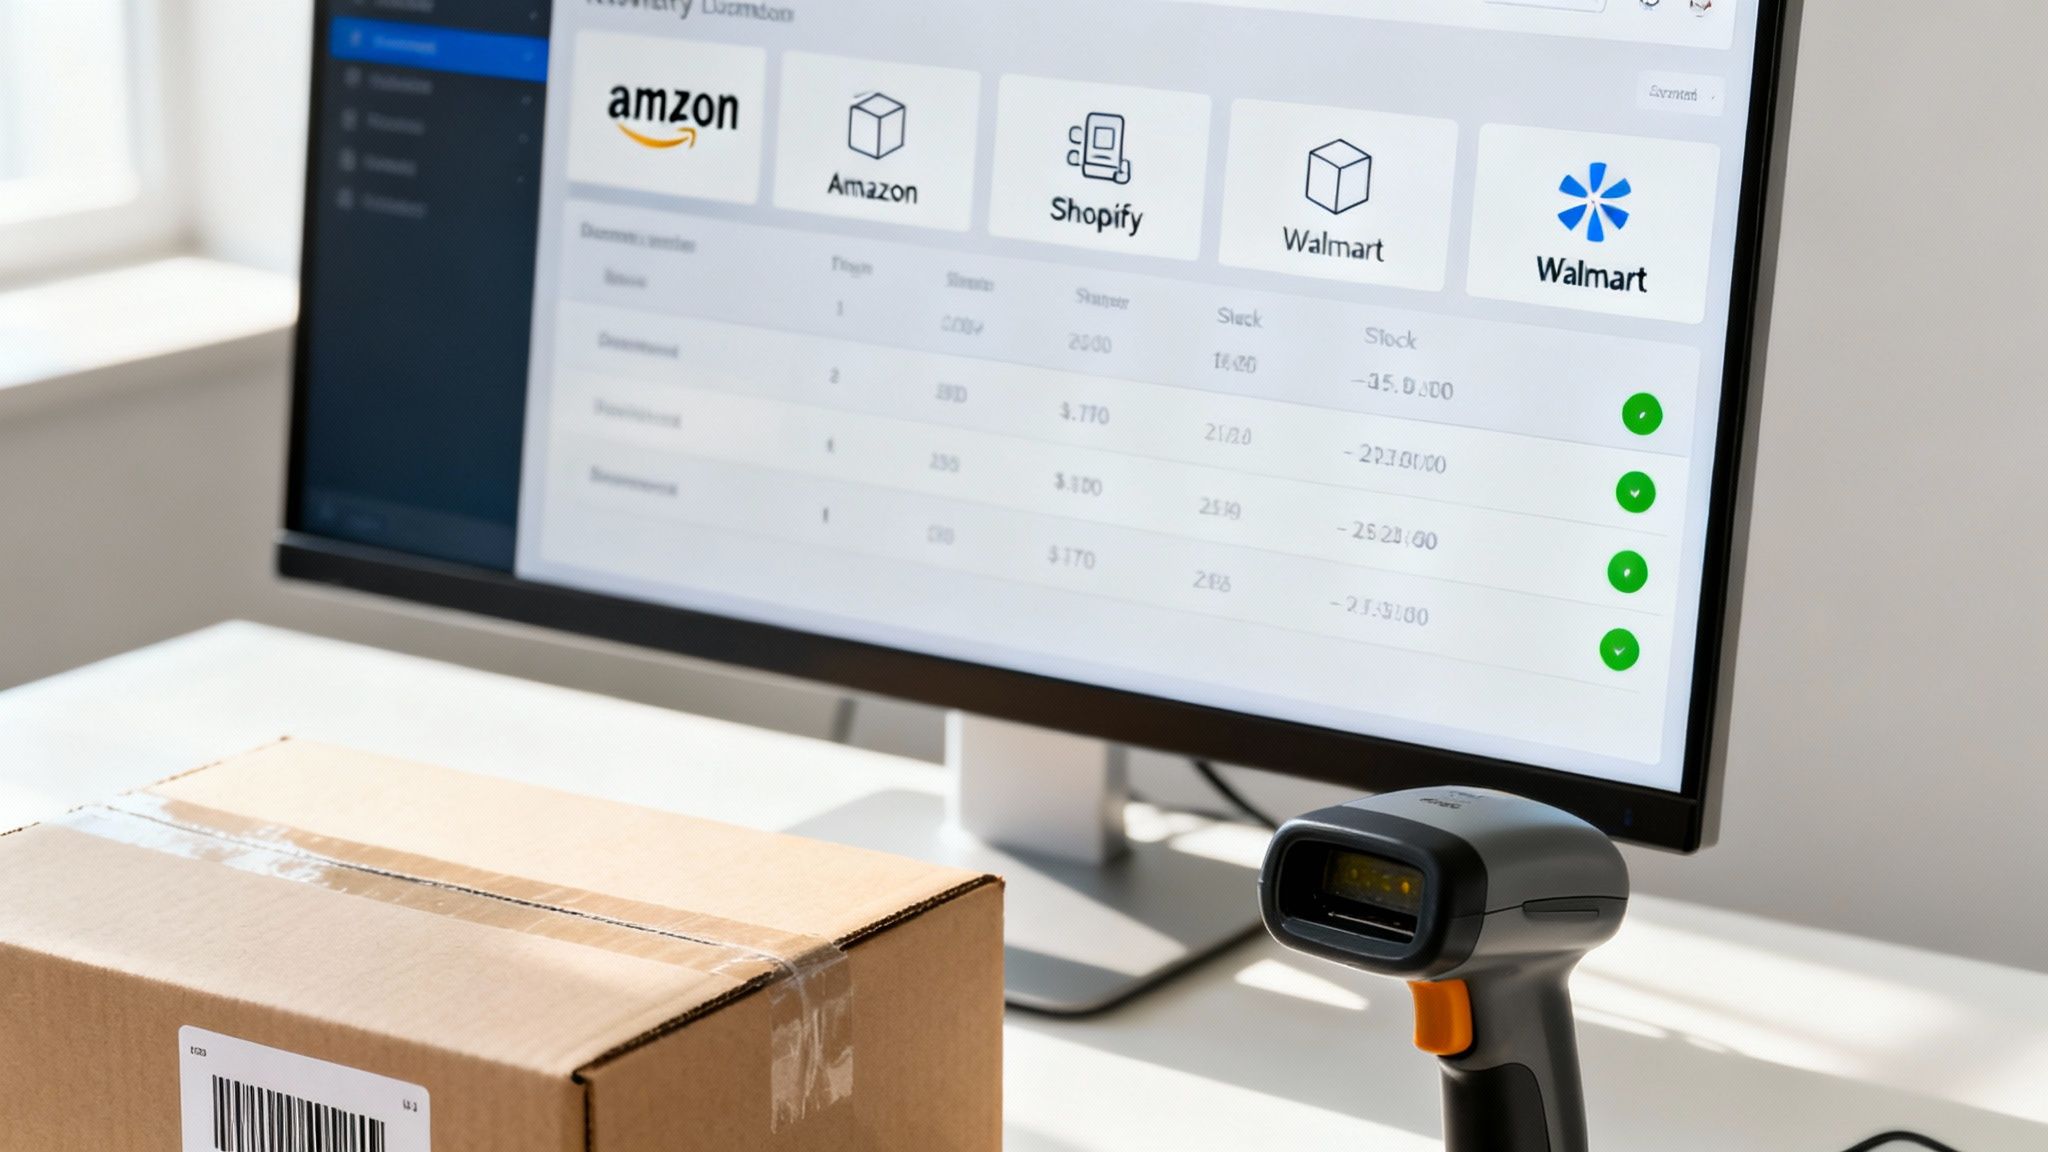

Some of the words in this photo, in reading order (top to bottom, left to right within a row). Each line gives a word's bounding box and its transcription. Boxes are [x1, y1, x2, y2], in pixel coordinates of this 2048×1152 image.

[608, 84, 739, 130] amzon
[827, 172, 919, 204] Amazon
[1050, 195, 1144, 237] Shopify
[1283, 227, 1384, 262] Walmart
[1536, 256, 1647, 292] Walmart
